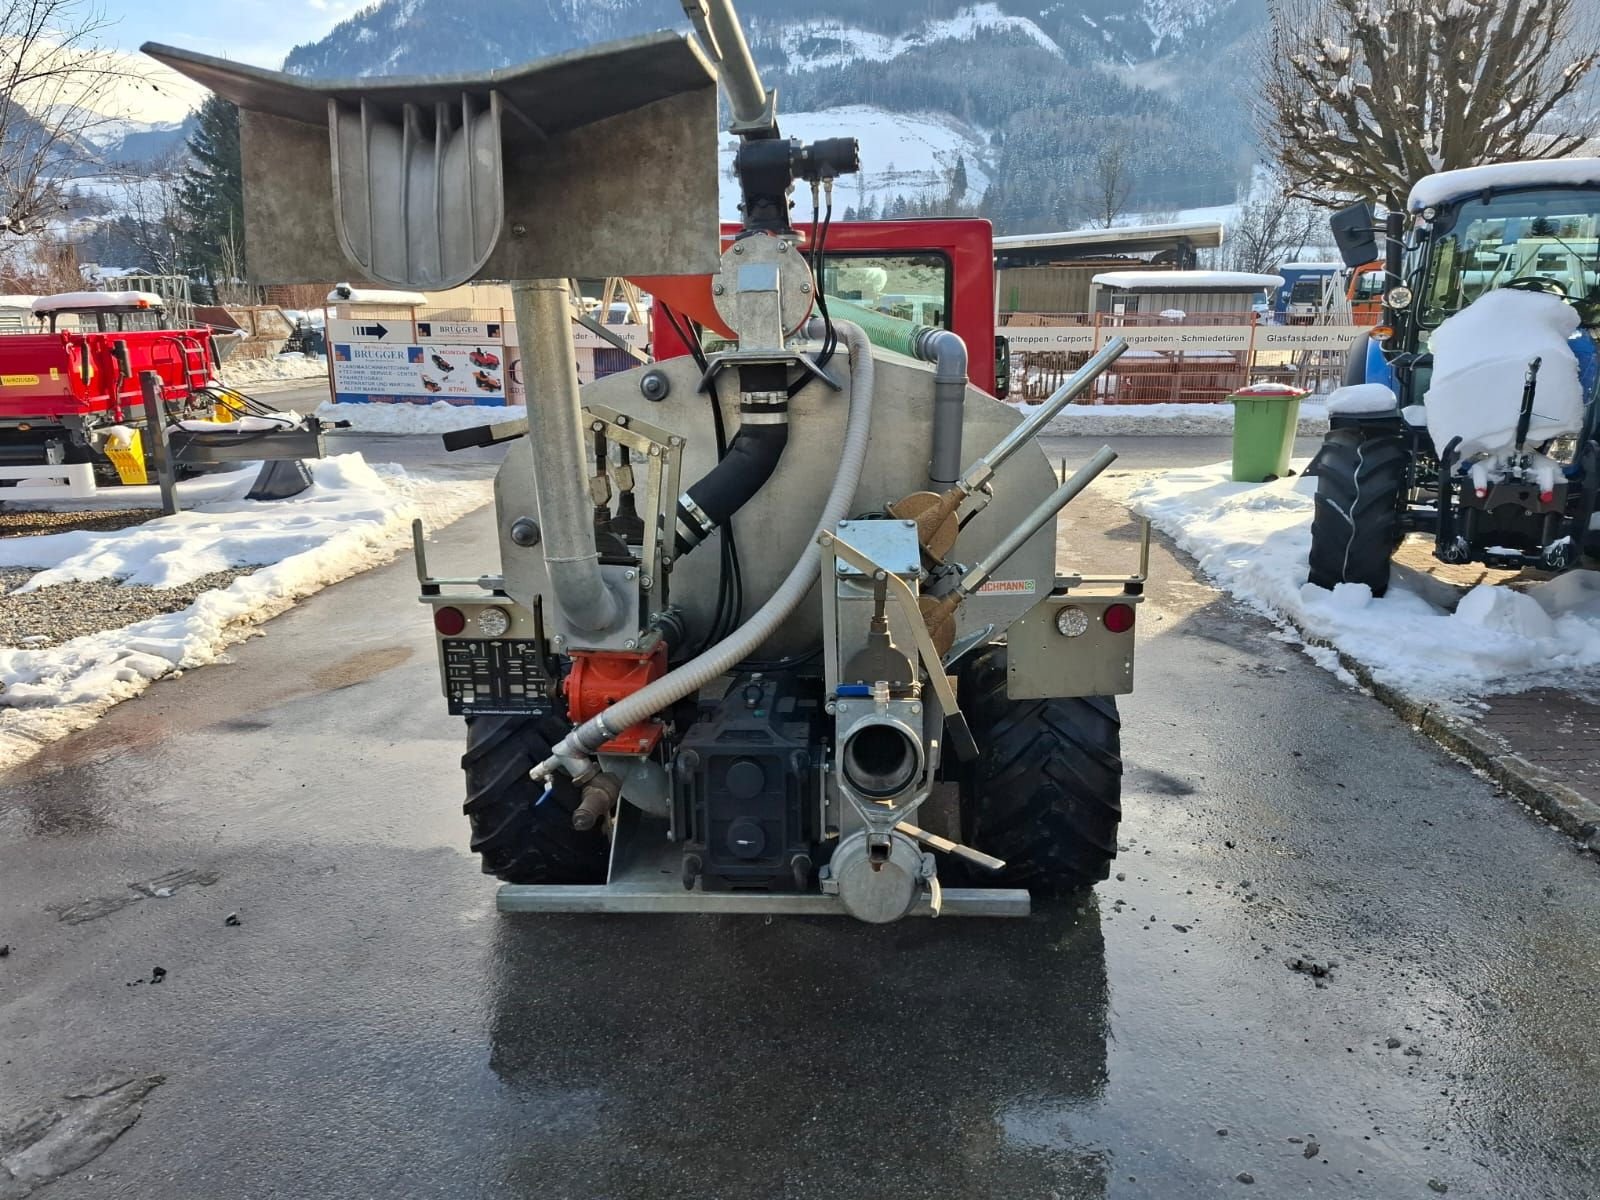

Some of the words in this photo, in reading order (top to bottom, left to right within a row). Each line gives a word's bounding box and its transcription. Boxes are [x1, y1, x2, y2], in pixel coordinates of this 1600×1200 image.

[1056, 335, 1093, 344] Carports
[1104, 335, 1174, 344] Msingarbeiten
[1181, 334, 1245, 342] Schmiedetüren
[1266, 334, 1329, 342] Glasfassaden
[979, 581, 1025, 592] UCHMANN
